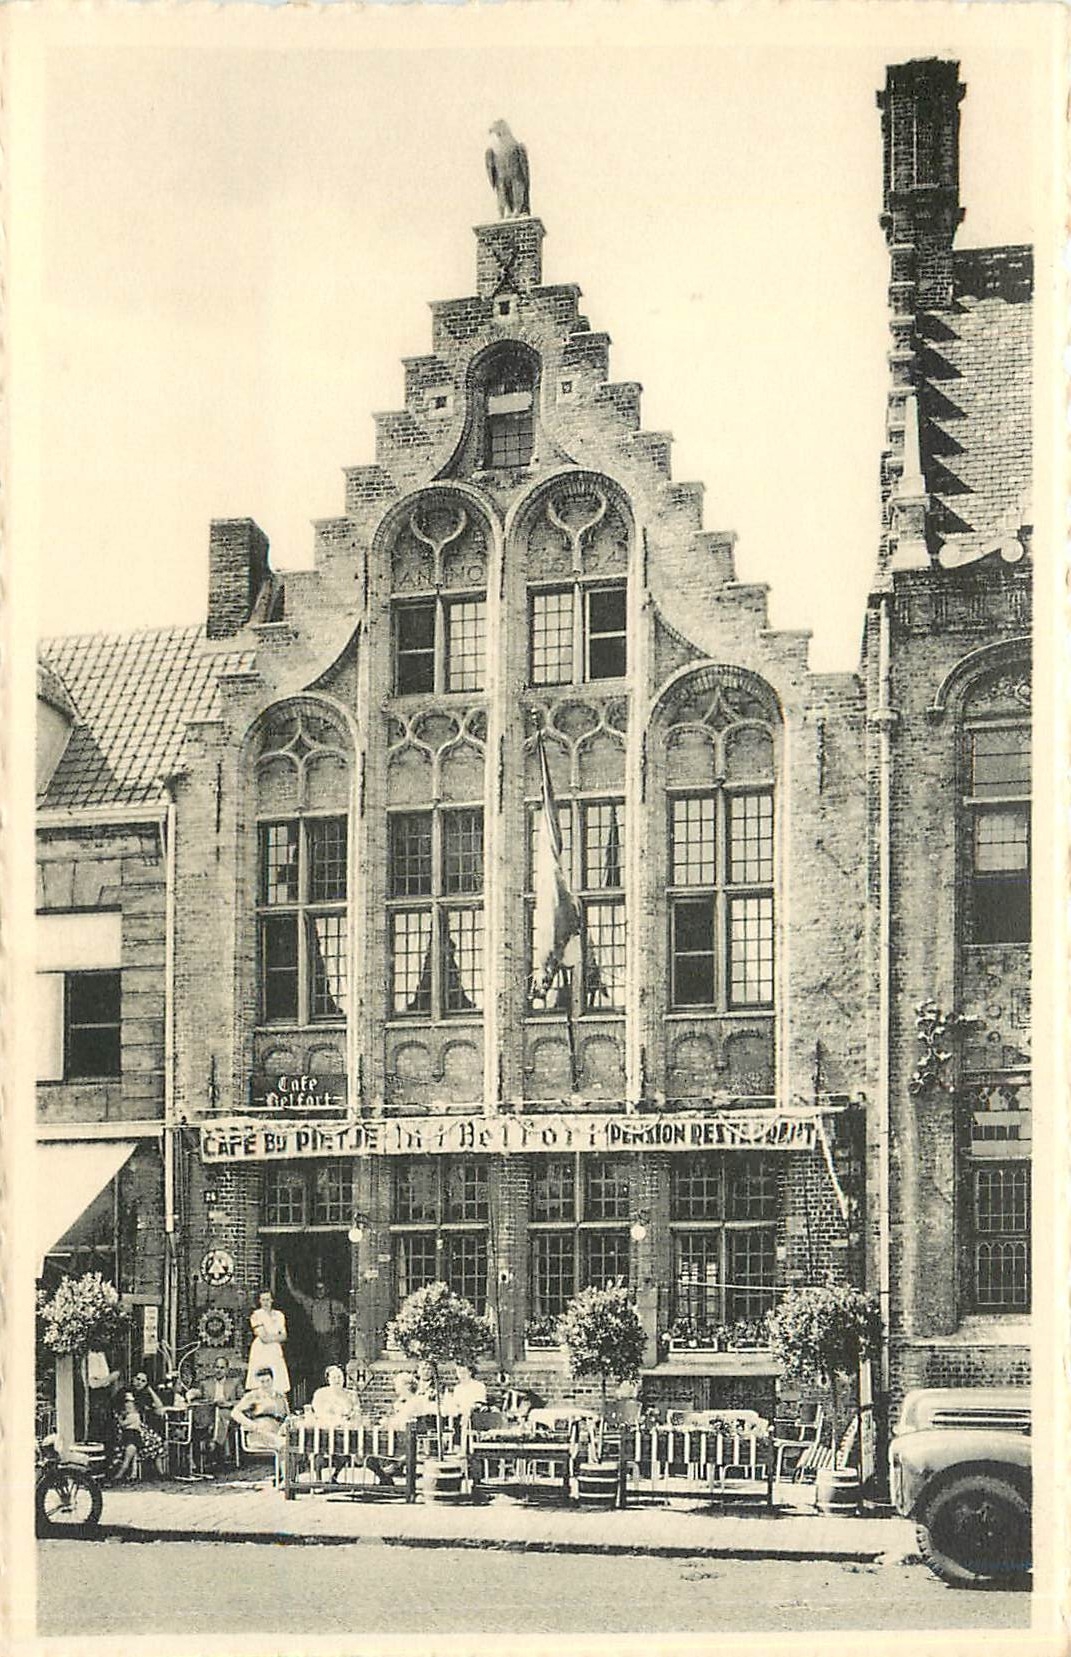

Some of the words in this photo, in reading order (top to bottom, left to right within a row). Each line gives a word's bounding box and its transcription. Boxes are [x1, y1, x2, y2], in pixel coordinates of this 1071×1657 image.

[278, 1075, 318, 1092] Cafe
[610, 1123, 686, 1144] PENSION
[356, 1369, 366, 1382] H
